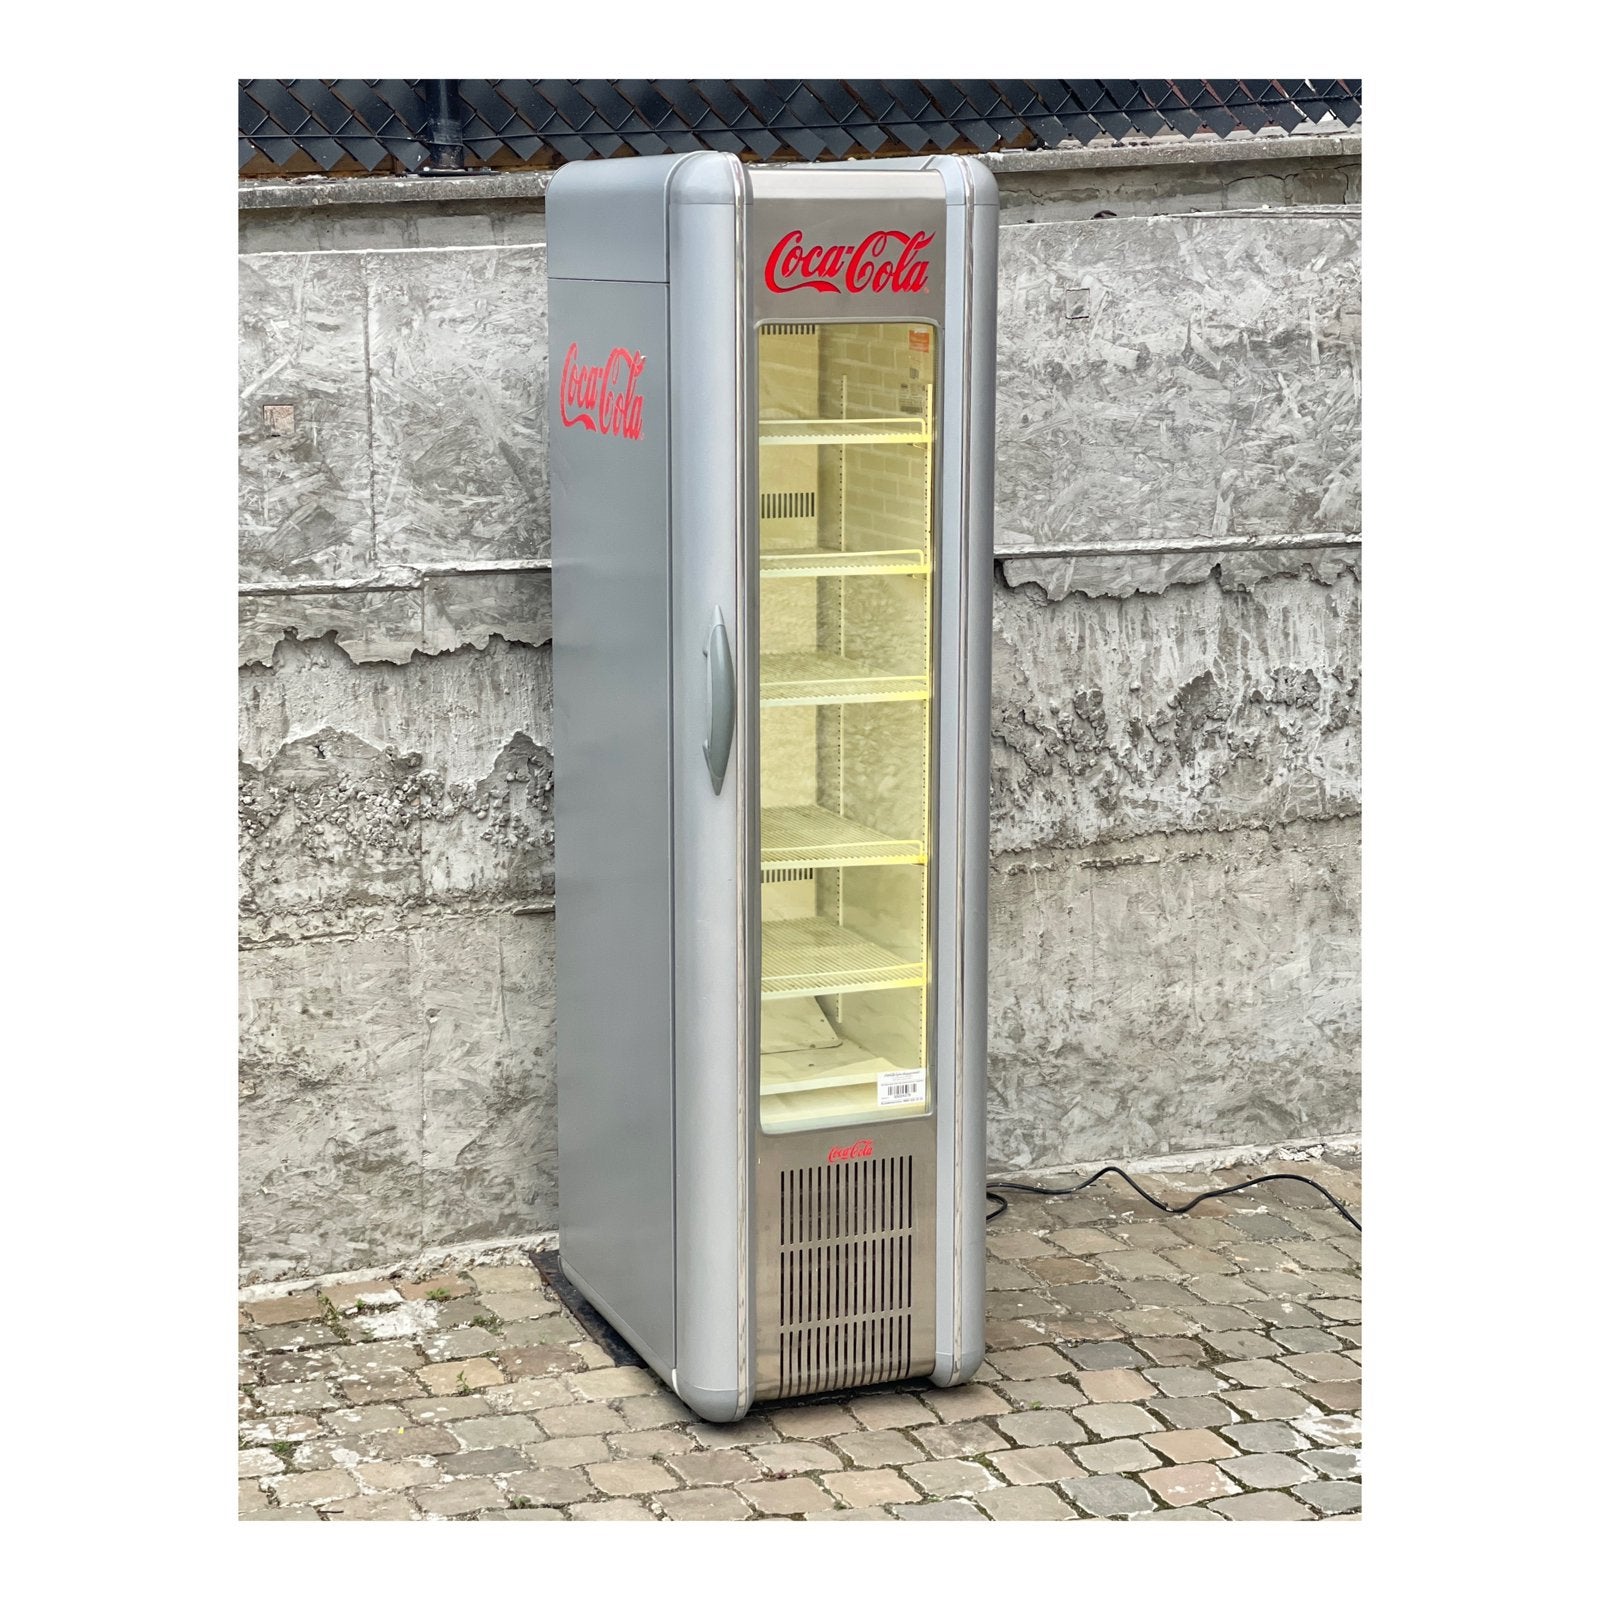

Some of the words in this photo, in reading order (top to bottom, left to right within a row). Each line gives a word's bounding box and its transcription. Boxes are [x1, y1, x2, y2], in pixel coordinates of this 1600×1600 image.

[764, 230, 936, 293] Coca-Cola
[560, 342, 646, 440] Coca-Cola
[828, 1139, 873, 1163] Coca-Cola
